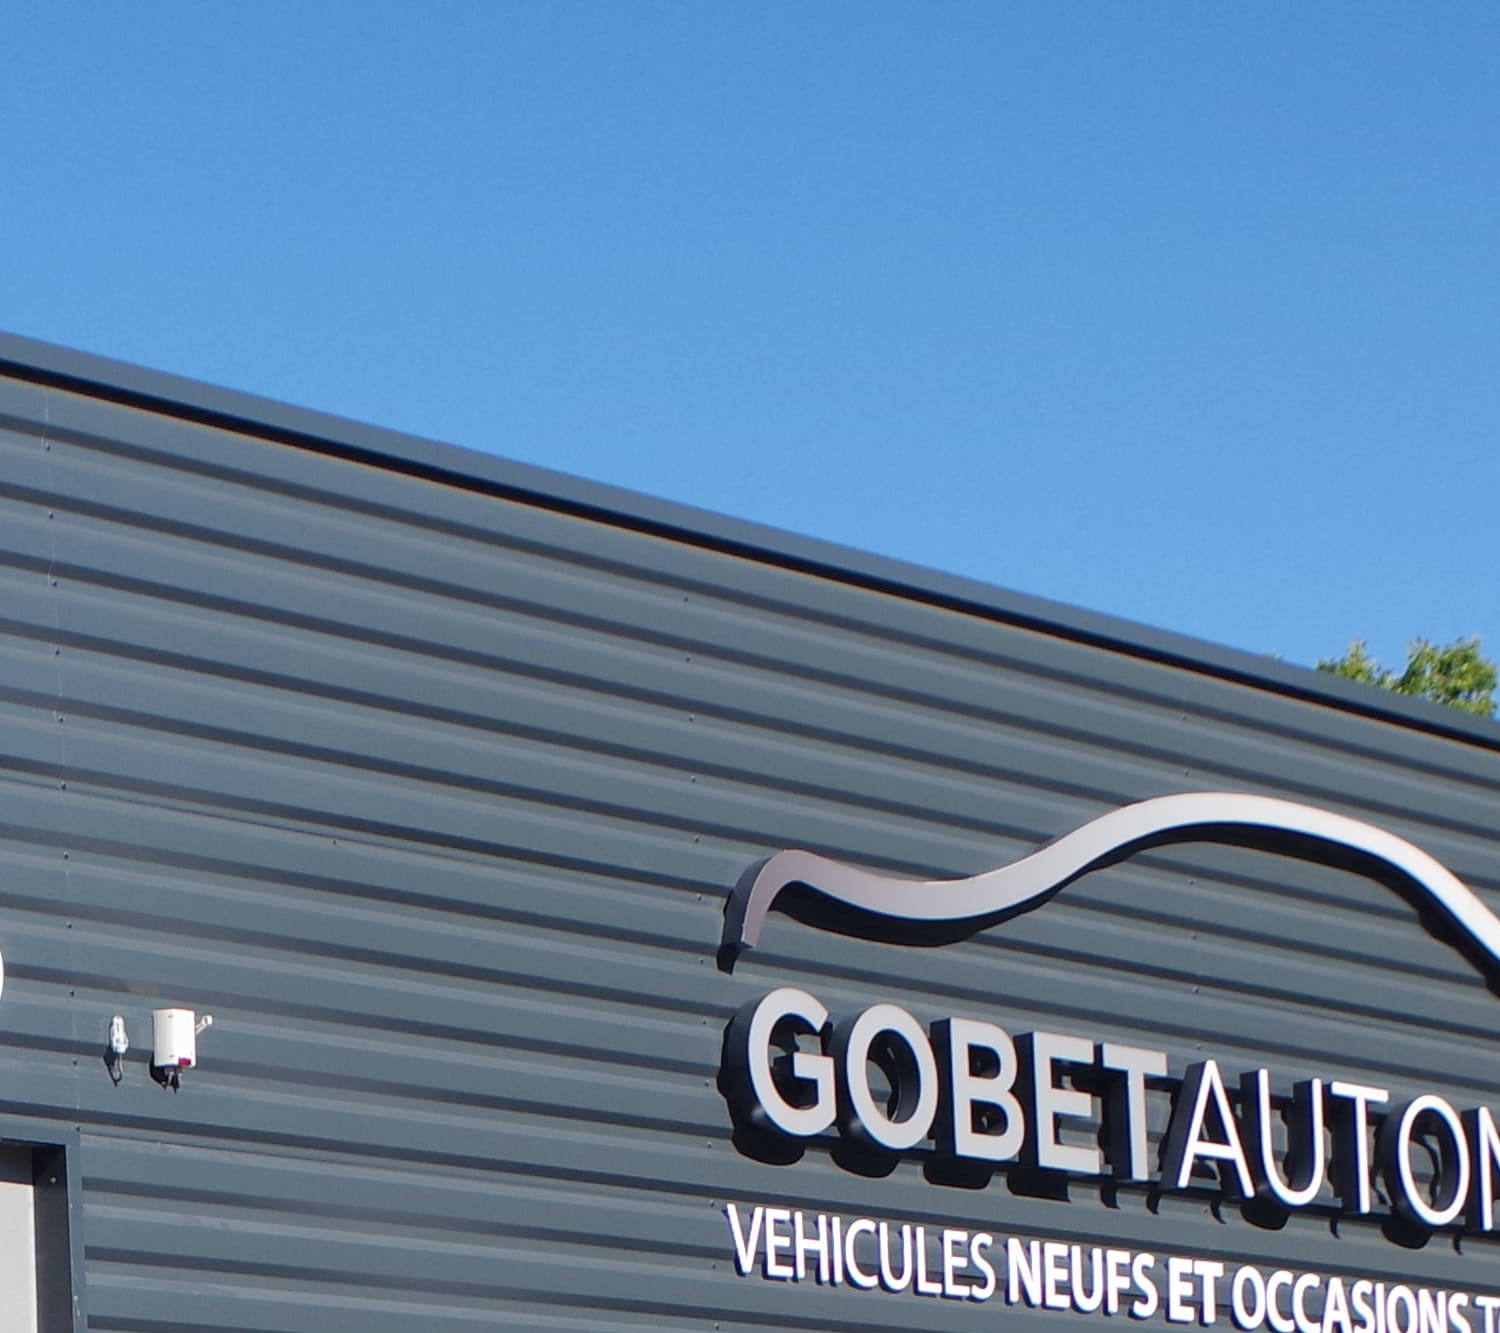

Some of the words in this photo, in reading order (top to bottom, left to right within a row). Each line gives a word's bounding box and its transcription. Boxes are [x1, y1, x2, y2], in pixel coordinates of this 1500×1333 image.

[727, 1204, 996, 1301] VEHICULES
[1007, 1238, 1157, 1321] NEUFS
[1168, 1261, 1225, 1326] ET
